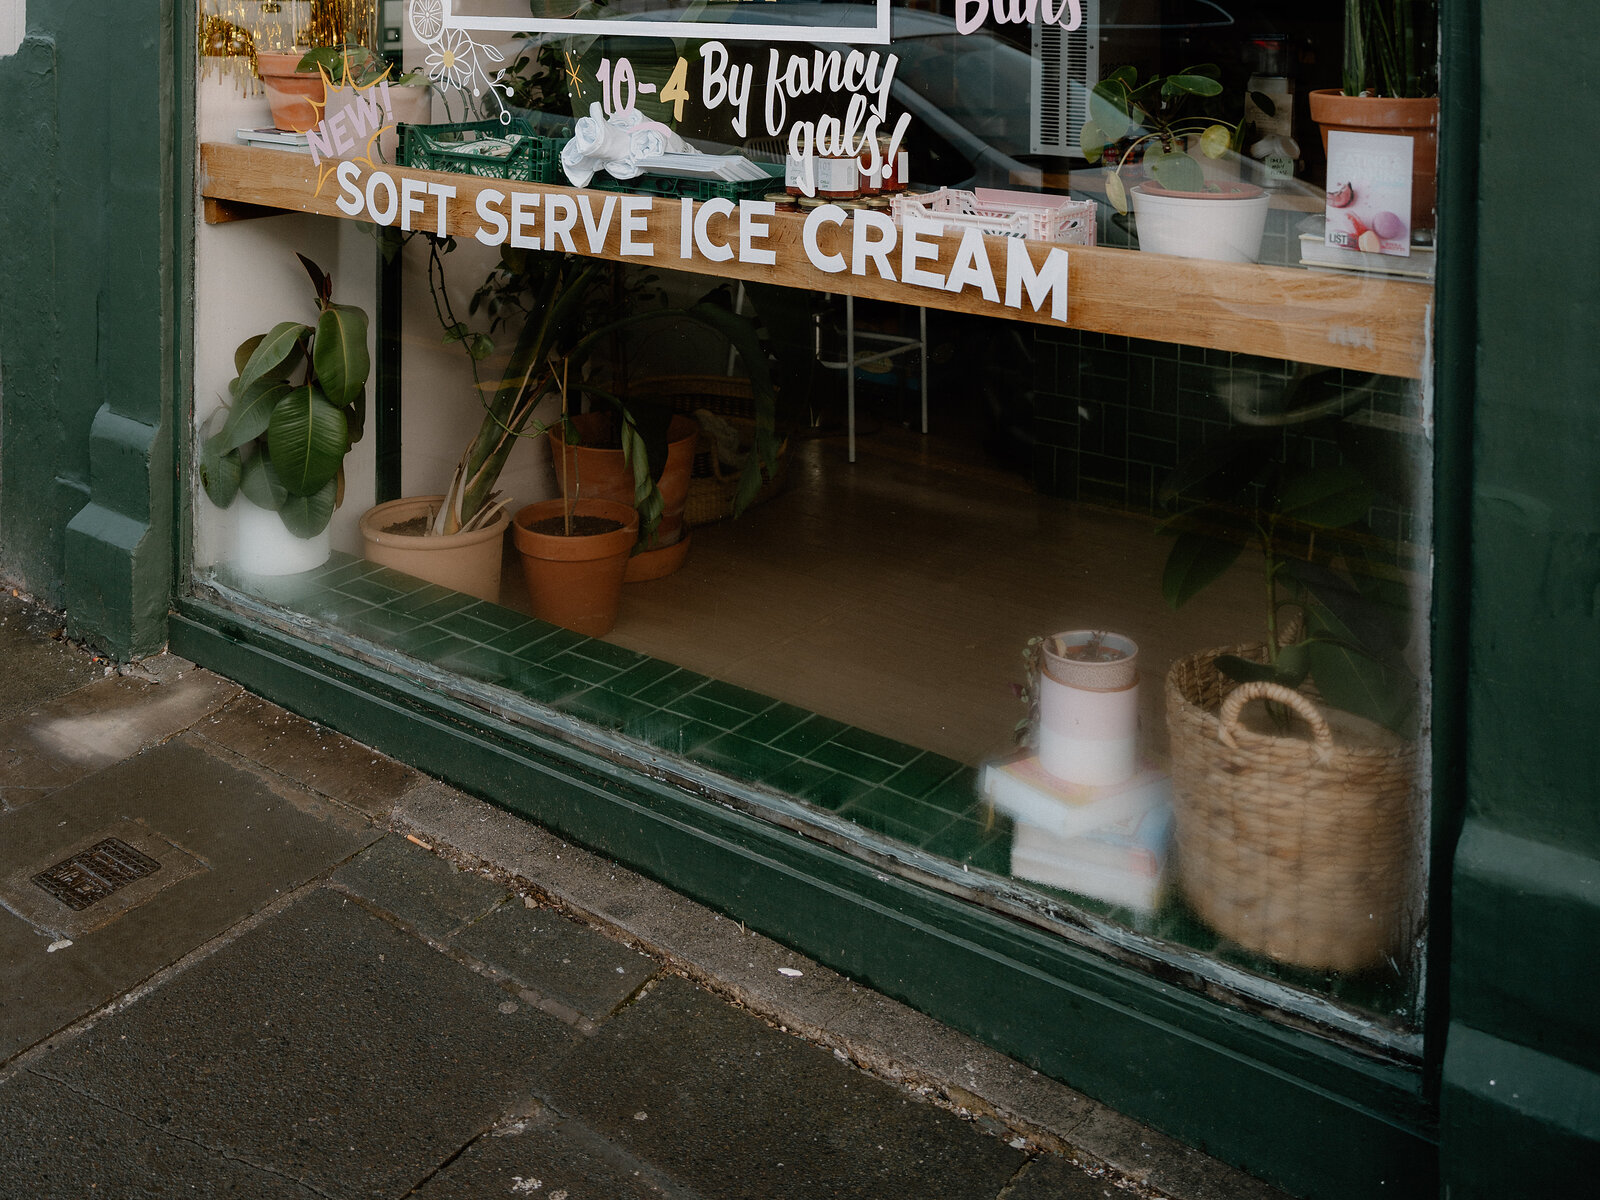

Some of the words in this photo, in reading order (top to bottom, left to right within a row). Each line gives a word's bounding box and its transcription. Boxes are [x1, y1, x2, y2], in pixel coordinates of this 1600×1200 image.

[305, 80, 394, 167] NEW!
[595, 56, 690, 122] 10-4
[700, 41, 753, 137] By
[765, 48, 899, 137] fancy
[789, 93, 912, 197] gals!
[335, 161, 457, 239] SOFT
[476, 188, 655, 257] SERVE
[680, 197, 778, 265] ICE
[802, 205, 1068, 323] CREAM
